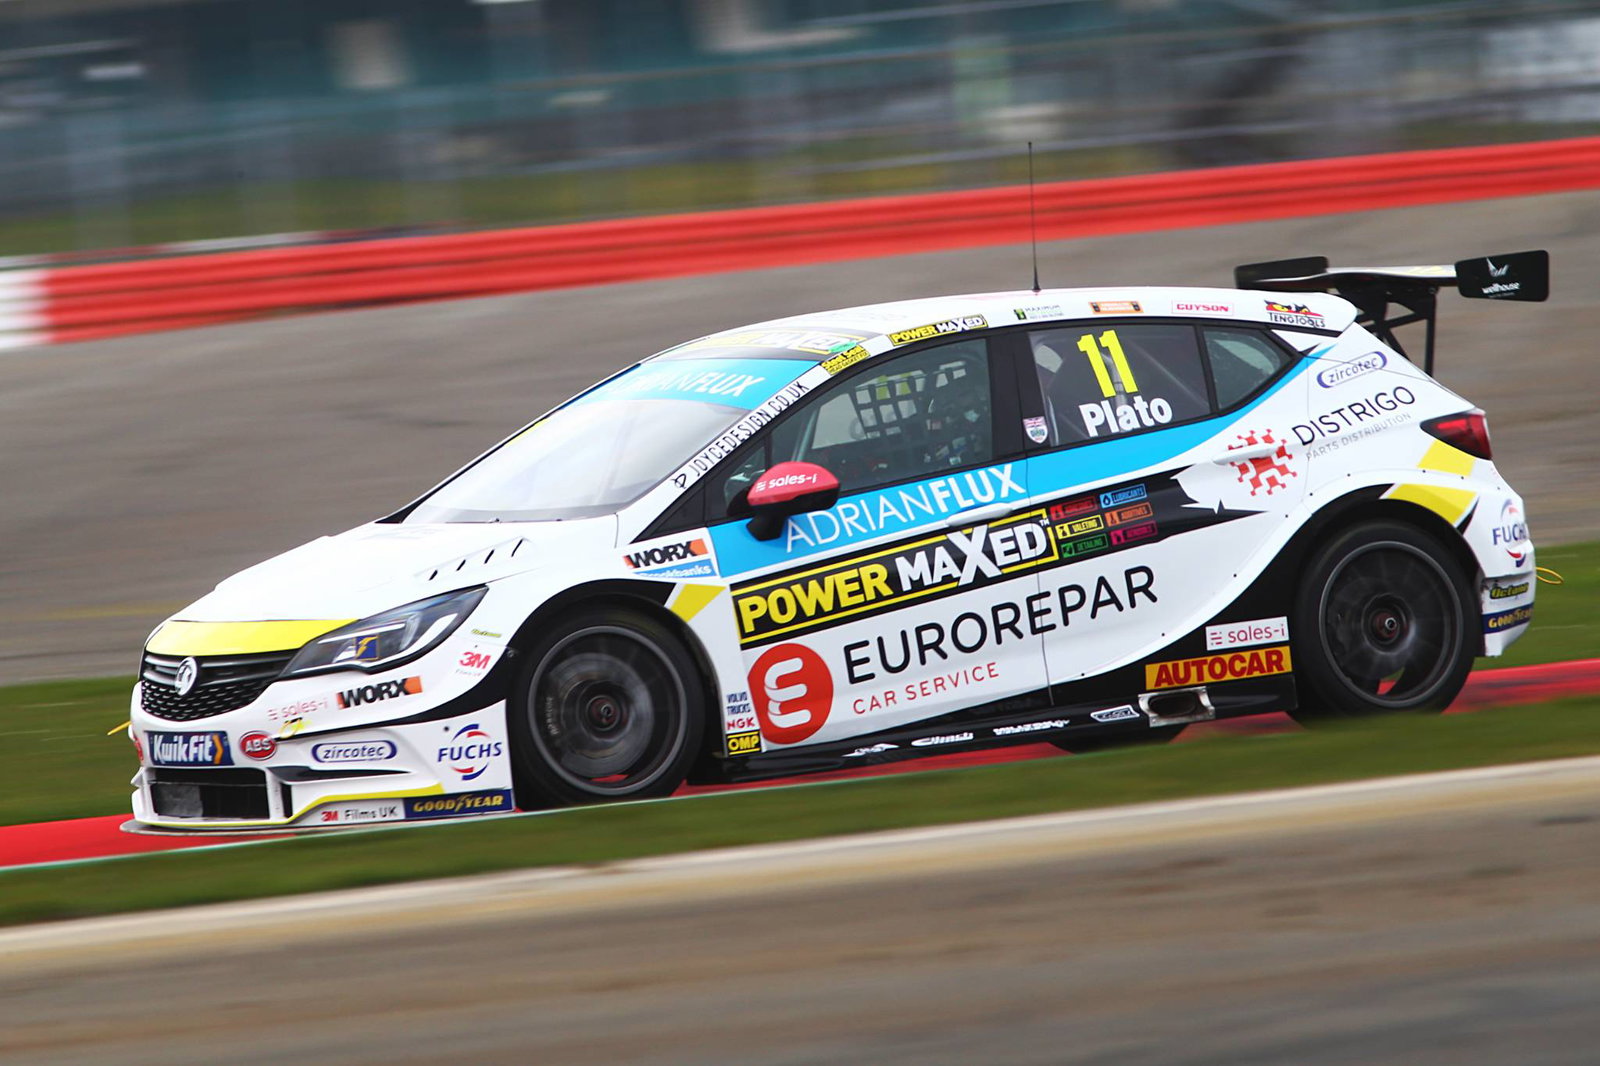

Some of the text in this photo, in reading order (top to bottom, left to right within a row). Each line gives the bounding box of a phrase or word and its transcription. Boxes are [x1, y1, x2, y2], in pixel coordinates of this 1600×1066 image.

[1176, 303, 1229, 312] GUYSON
[891, 317, 983, 342] POWER MAXED
[1077, 330, 1138, 398] 11
[1328, 356, 1378, 383] zircotec
[1078, 395, 1172, 437] Plato
[1292, 386, 1415, 446] DISTRIGO
[688, 381, 810, 477] JOYCEDESIGN.CO.UK
[1306, 413, 1411, 461] PARTS DISTRIBUTION
[768, 472, 817, 489] sales-i
[787, 463, 1026, 553] ADRIANFLUX
[626, 541, 698, 568] WORX
[737, 563, 893, 633] POWER
[895, 523, 1047, 591] MAXED
[843, 565, 1158, 685] EUROREPAR
[1228, 624, 1285, 643] sales-i
[460, 651, 491, 669] 3M
[1154, 650, 1284, 687] AUTOCAR
[338, 677, 410, 709] WORX
[726, 691, 748, 703] VOLVO
[853, 661, 1000, 715] CAR SERVICE
[281, 698, 328, 718] sales-i
[726, 703, 751, 715] TRUCKS
[727, 717, 755, 730] NGK
[245, 738, 272, 753] ABS
[323, 745, 385, 760] zircotec
[438, 742, 502, 762] FUCHS
[728, 735, 759, 751] OMP
[322, 806, 397, 822] 3M Films UK
